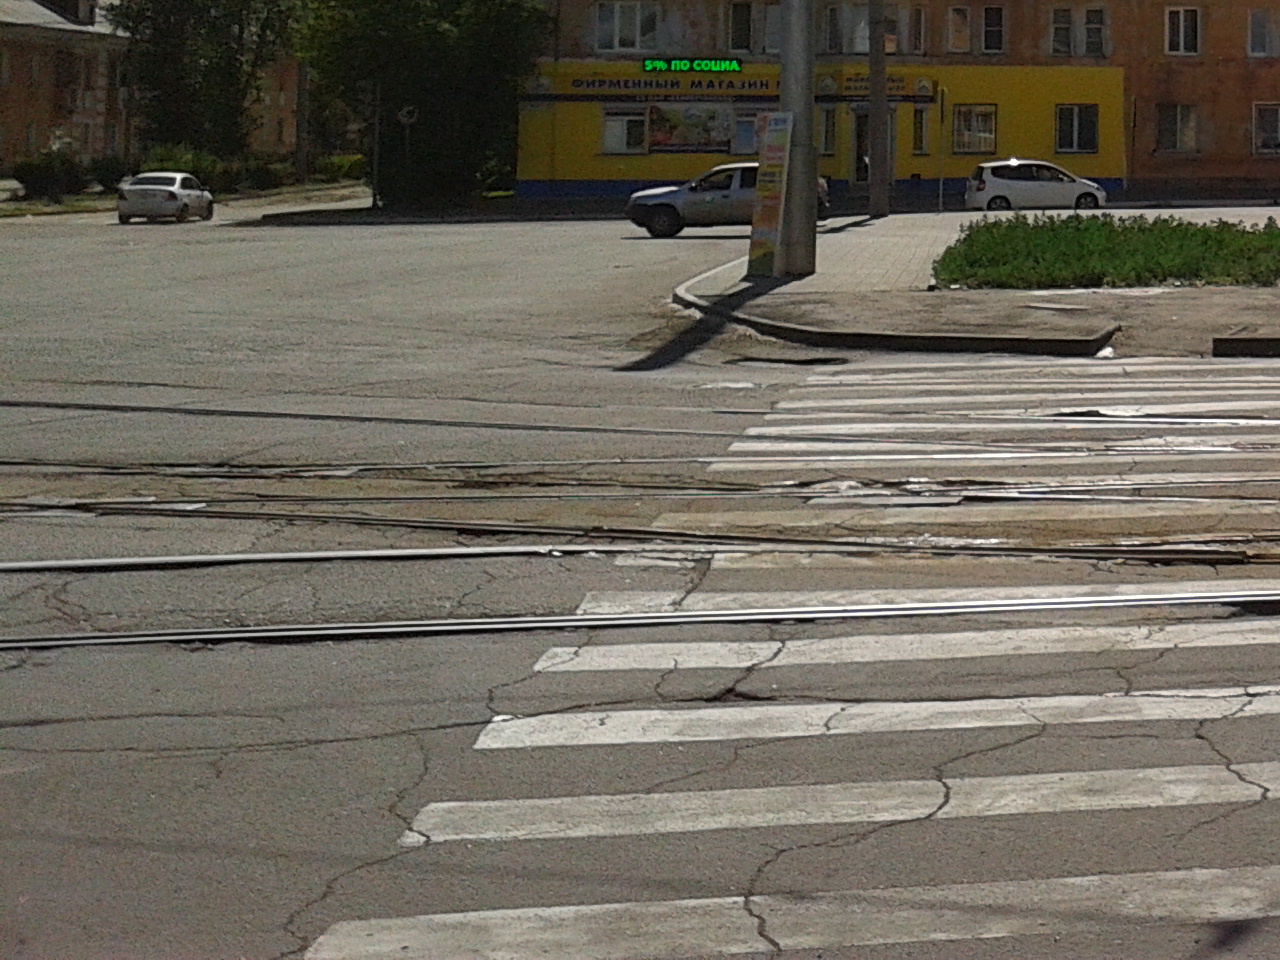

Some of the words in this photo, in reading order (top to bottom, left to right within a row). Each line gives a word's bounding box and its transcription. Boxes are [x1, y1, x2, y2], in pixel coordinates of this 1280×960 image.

[644, 60, 668, 72] 5%
[670, 60, 691, 72] ПО
[570, 77, 680, 90] ФИРМЕННЫЙ
[689, 79, 770, 90] МАГАЗИН
